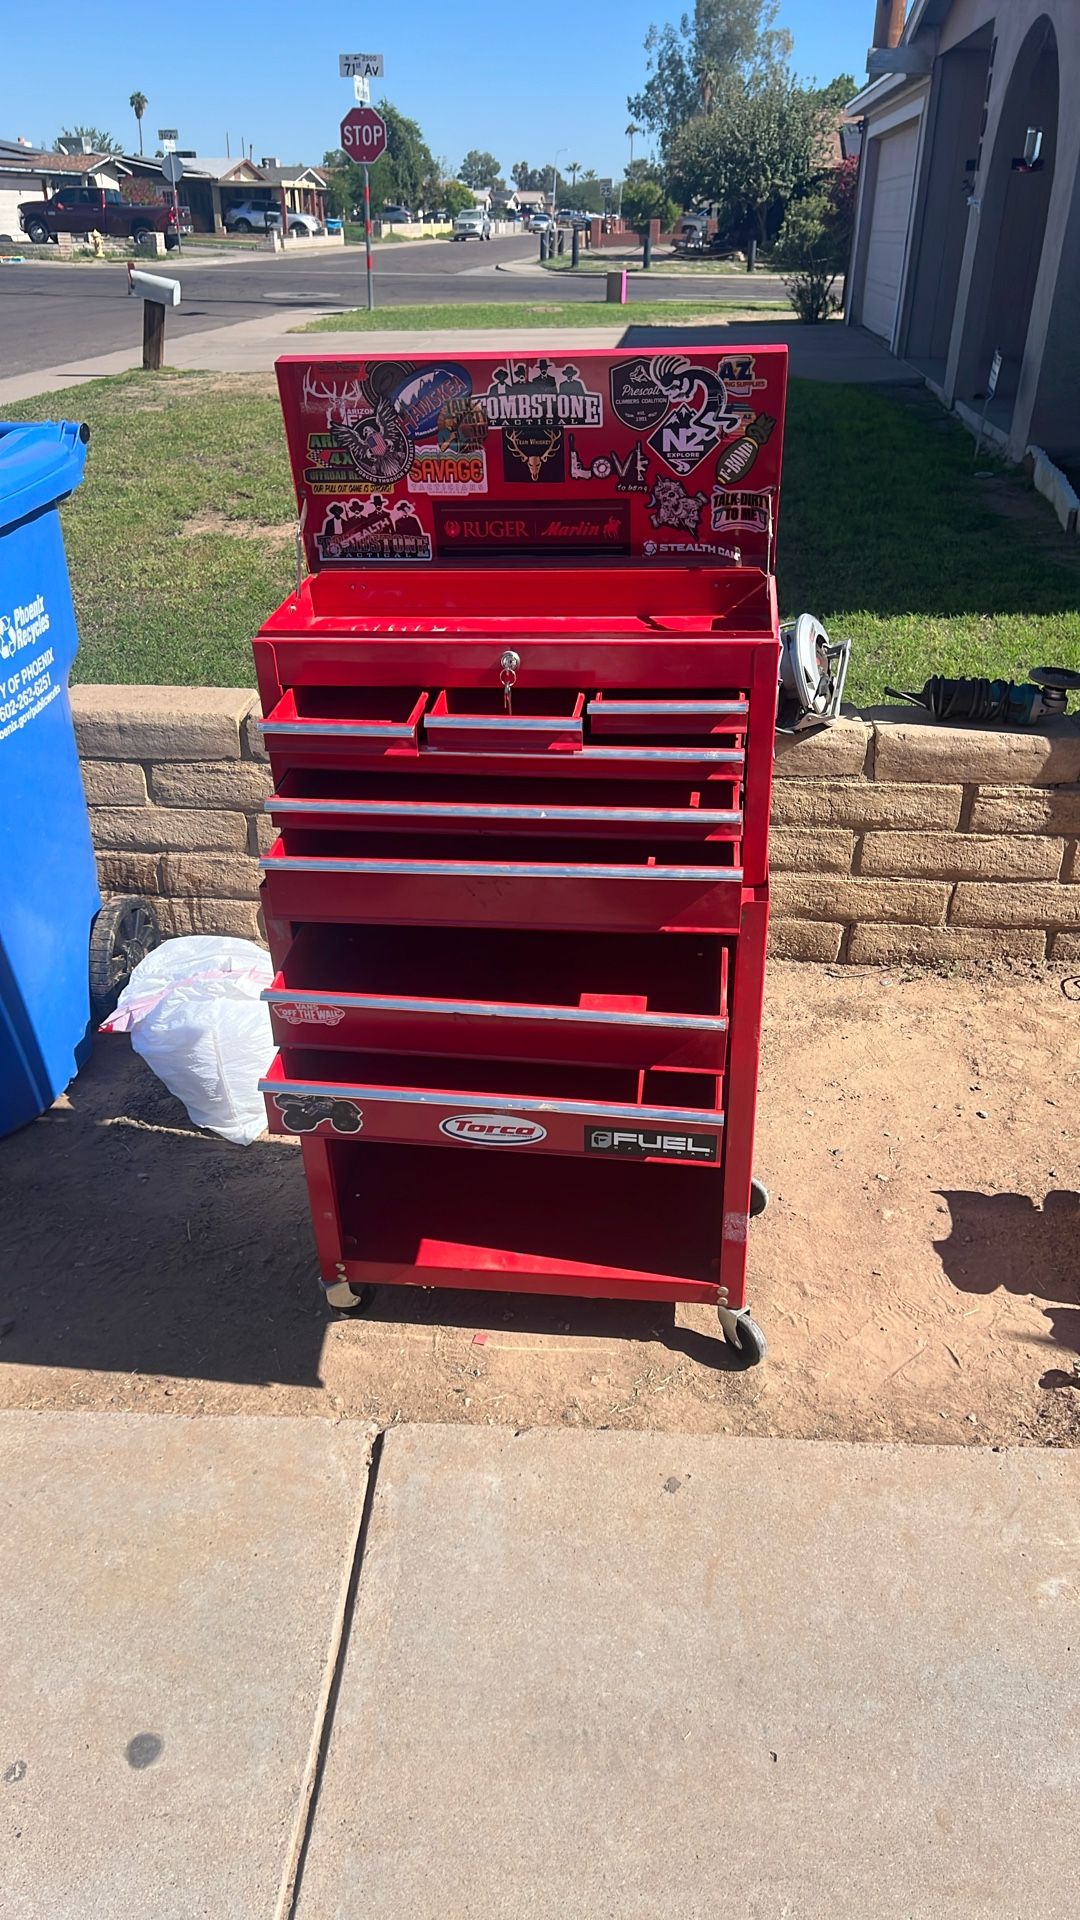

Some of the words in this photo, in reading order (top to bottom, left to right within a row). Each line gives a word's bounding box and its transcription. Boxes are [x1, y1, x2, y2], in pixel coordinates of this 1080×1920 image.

[364, 63, 379, 76] Av
[344, 125, 382, 146] STOP
[720, 360, 753, 380] AZ
[395, 375, 468, 436] HAMSKEA
[410, 458, 485, 483] SAVAGE
[719, 442, 754, 481] F-BOMB
[378, 472, 404, 483] THROUGH
[349, 484, 363, 493] GAME
[714, 493, 737, 508] TALK
[740, 492, 770, 506] DIRTY
[725, 507, 738, 520] TO
[740, 507, 758, 520] ME
[340, 518, 390, 549] STEALTH
[463, 521, 528, 538] RUGER
[541, 521, 599, 536] Marlin
[660, 544, 717, 554] STEALTH
[14, 594, 45, 630] Phoenix
[16, 613, 50, 651] Recycles
[8, 673, 20, 694] OF
[20, 647, 55, 686] PHOENIX
[299, 1010, 316, 1020] THE
[454, 1120, 536, 1136] Torco
[613, 1132, 711, 1153] FUEL
